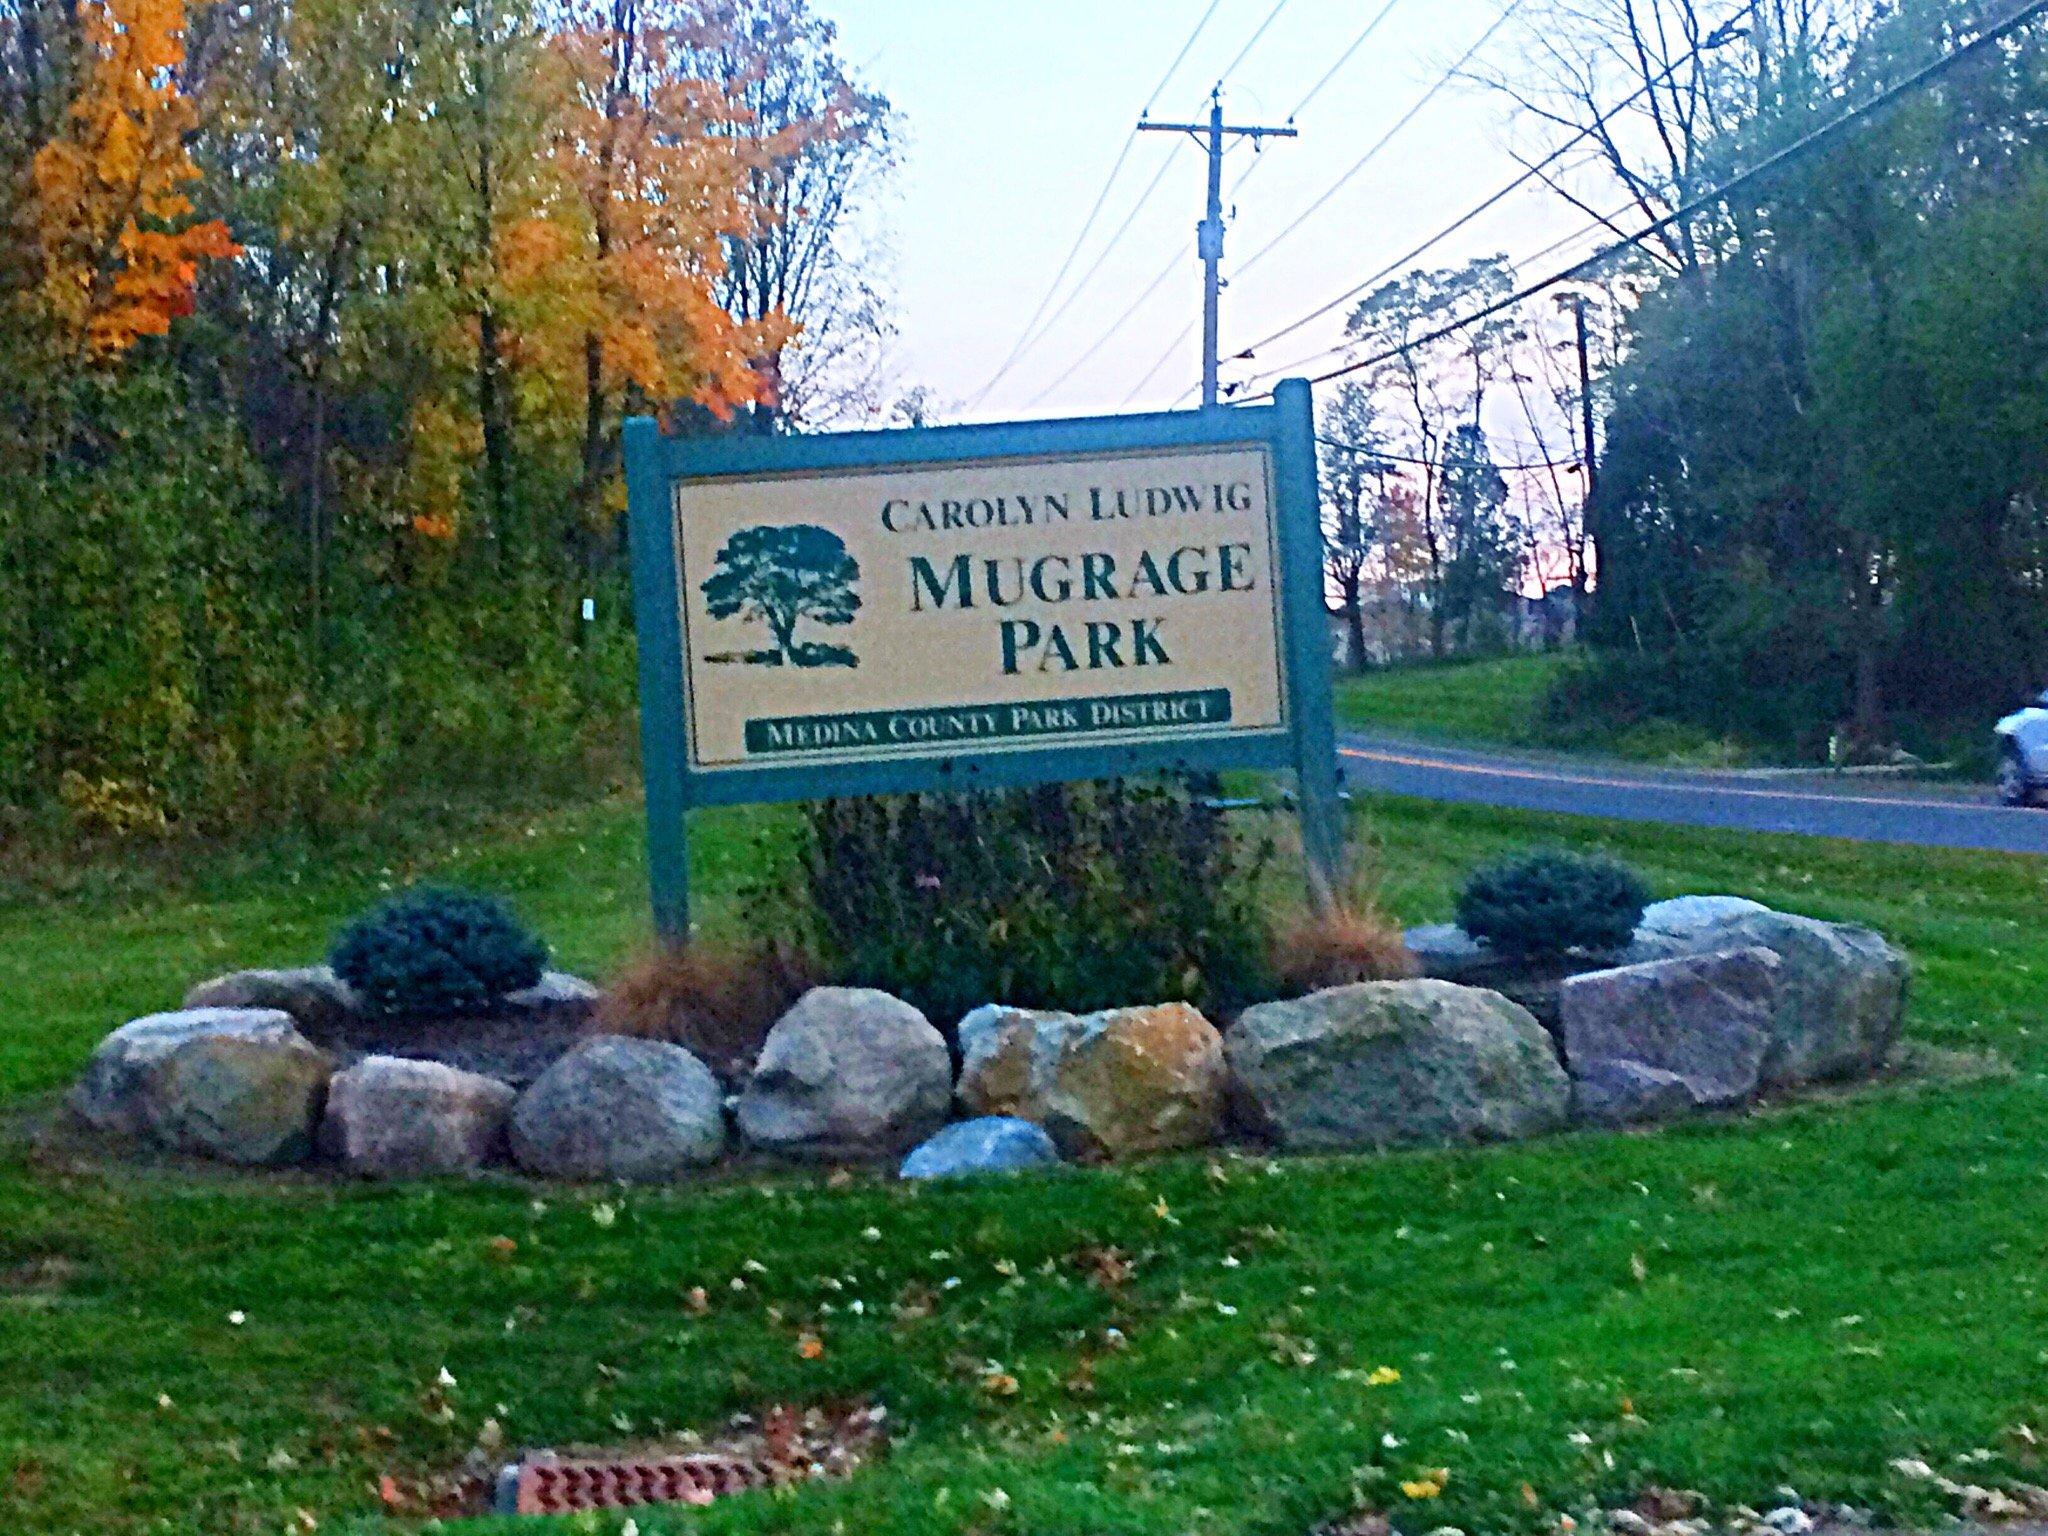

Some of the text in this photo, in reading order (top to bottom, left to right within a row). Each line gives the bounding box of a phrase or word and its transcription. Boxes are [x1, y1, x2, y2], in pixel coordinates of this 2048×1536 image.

[881, 482, 1252, 533] CAROLYN LUDWIG
[910, 542, 1255, 612] MUGRAGE
[999, 617, 1172, 675] PARK
[767, 697, 1209, 747] MEDINA COUNTY PARK DISTRICT
